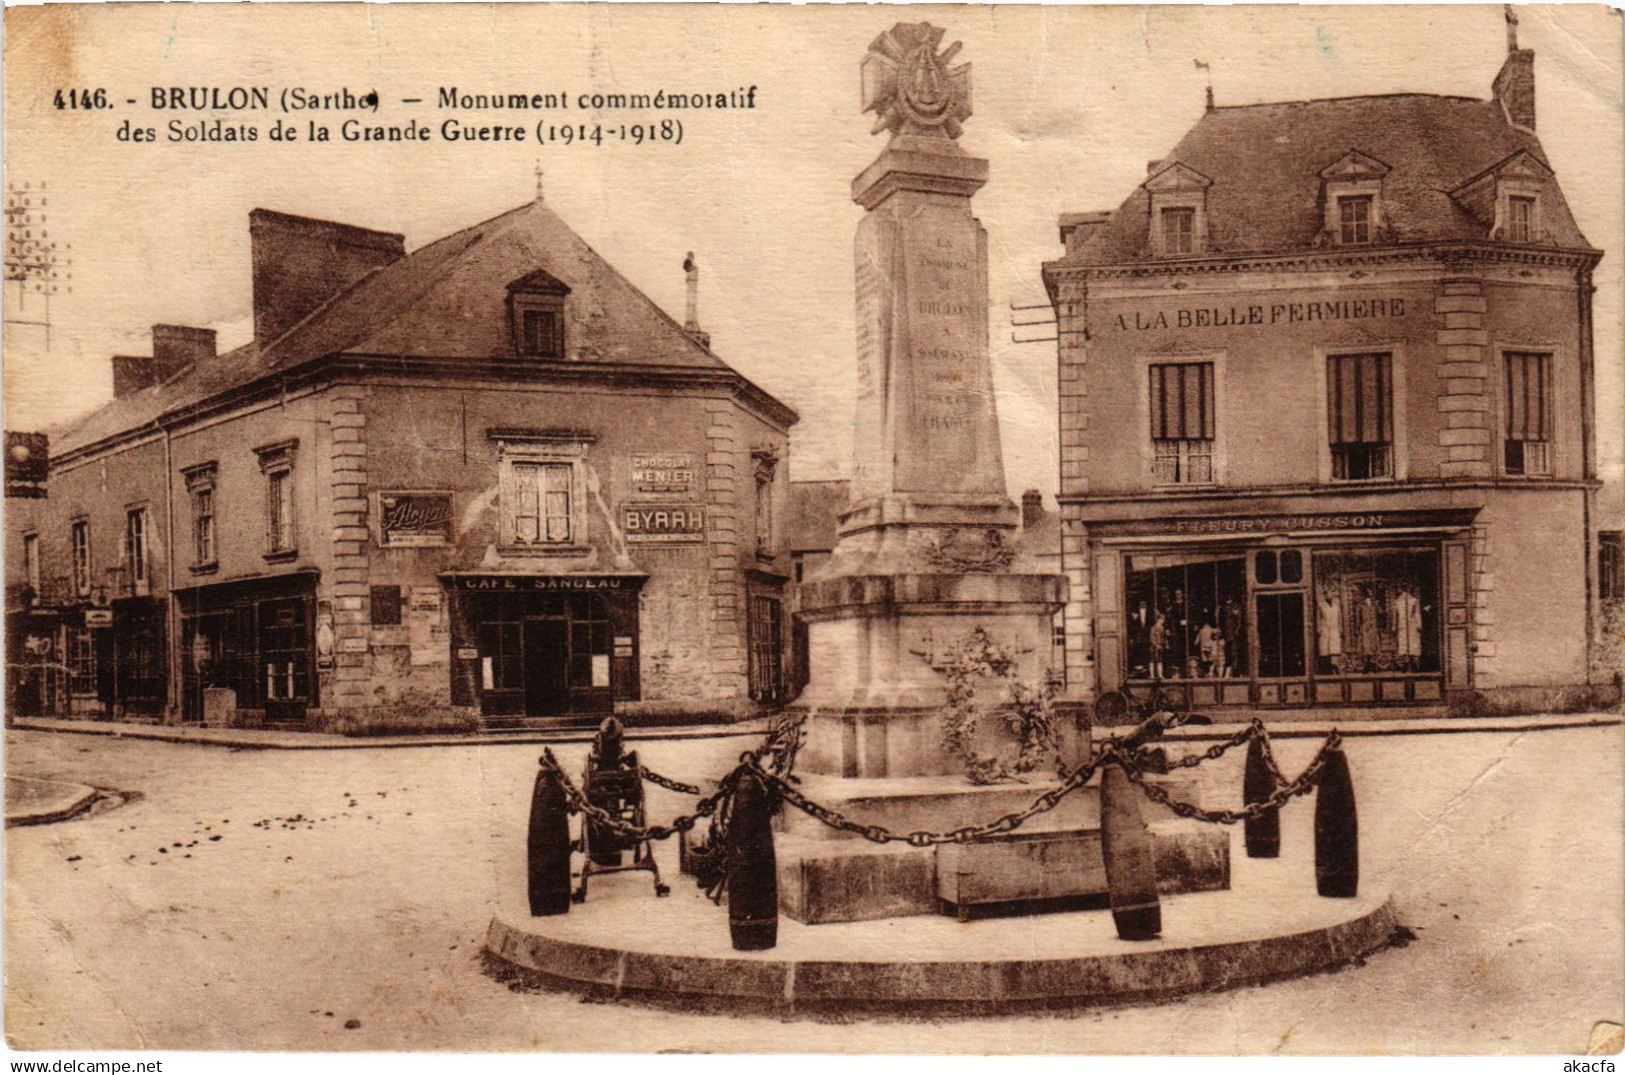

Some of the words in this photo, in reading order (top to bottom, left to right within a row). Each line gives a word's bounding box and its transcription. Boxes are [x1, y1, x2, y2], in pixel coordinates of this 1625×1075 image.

[1135, 310, 1169, 332] LA
[1177, 304, 1264, 329] BELLE
[1270, 297, 1407, 325] FERMIERE
[632, 471, 694, 482] MENIER
[625, 511, 704, 529] BYRRH
